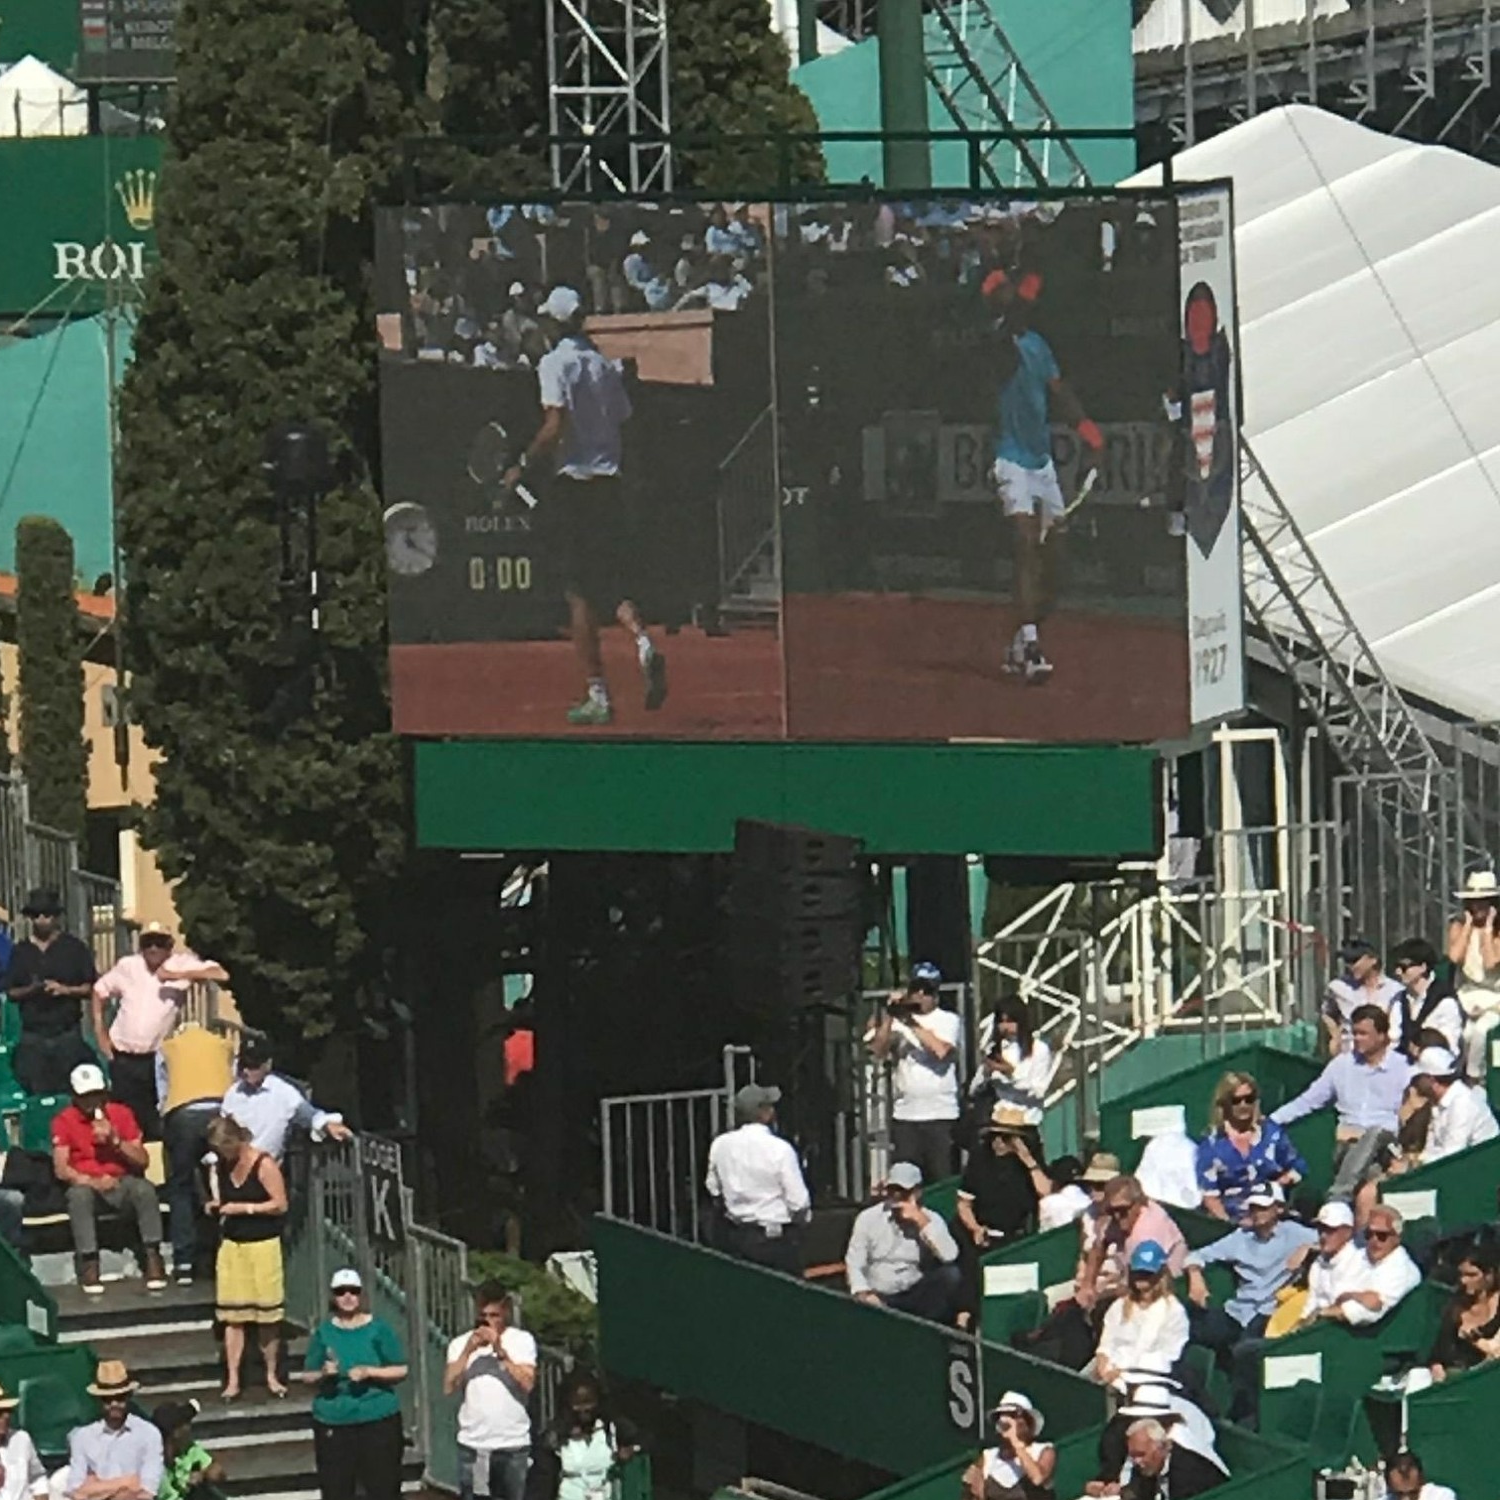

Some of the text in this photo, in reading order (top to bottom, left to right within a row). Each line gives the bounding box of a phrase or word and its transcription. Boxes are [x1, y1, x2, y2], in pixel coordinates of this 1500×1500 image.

[52, 241, 146, 280] ROL
[370, 1174, 396, 1240] K
[949, 1360, 975, 1429] S
